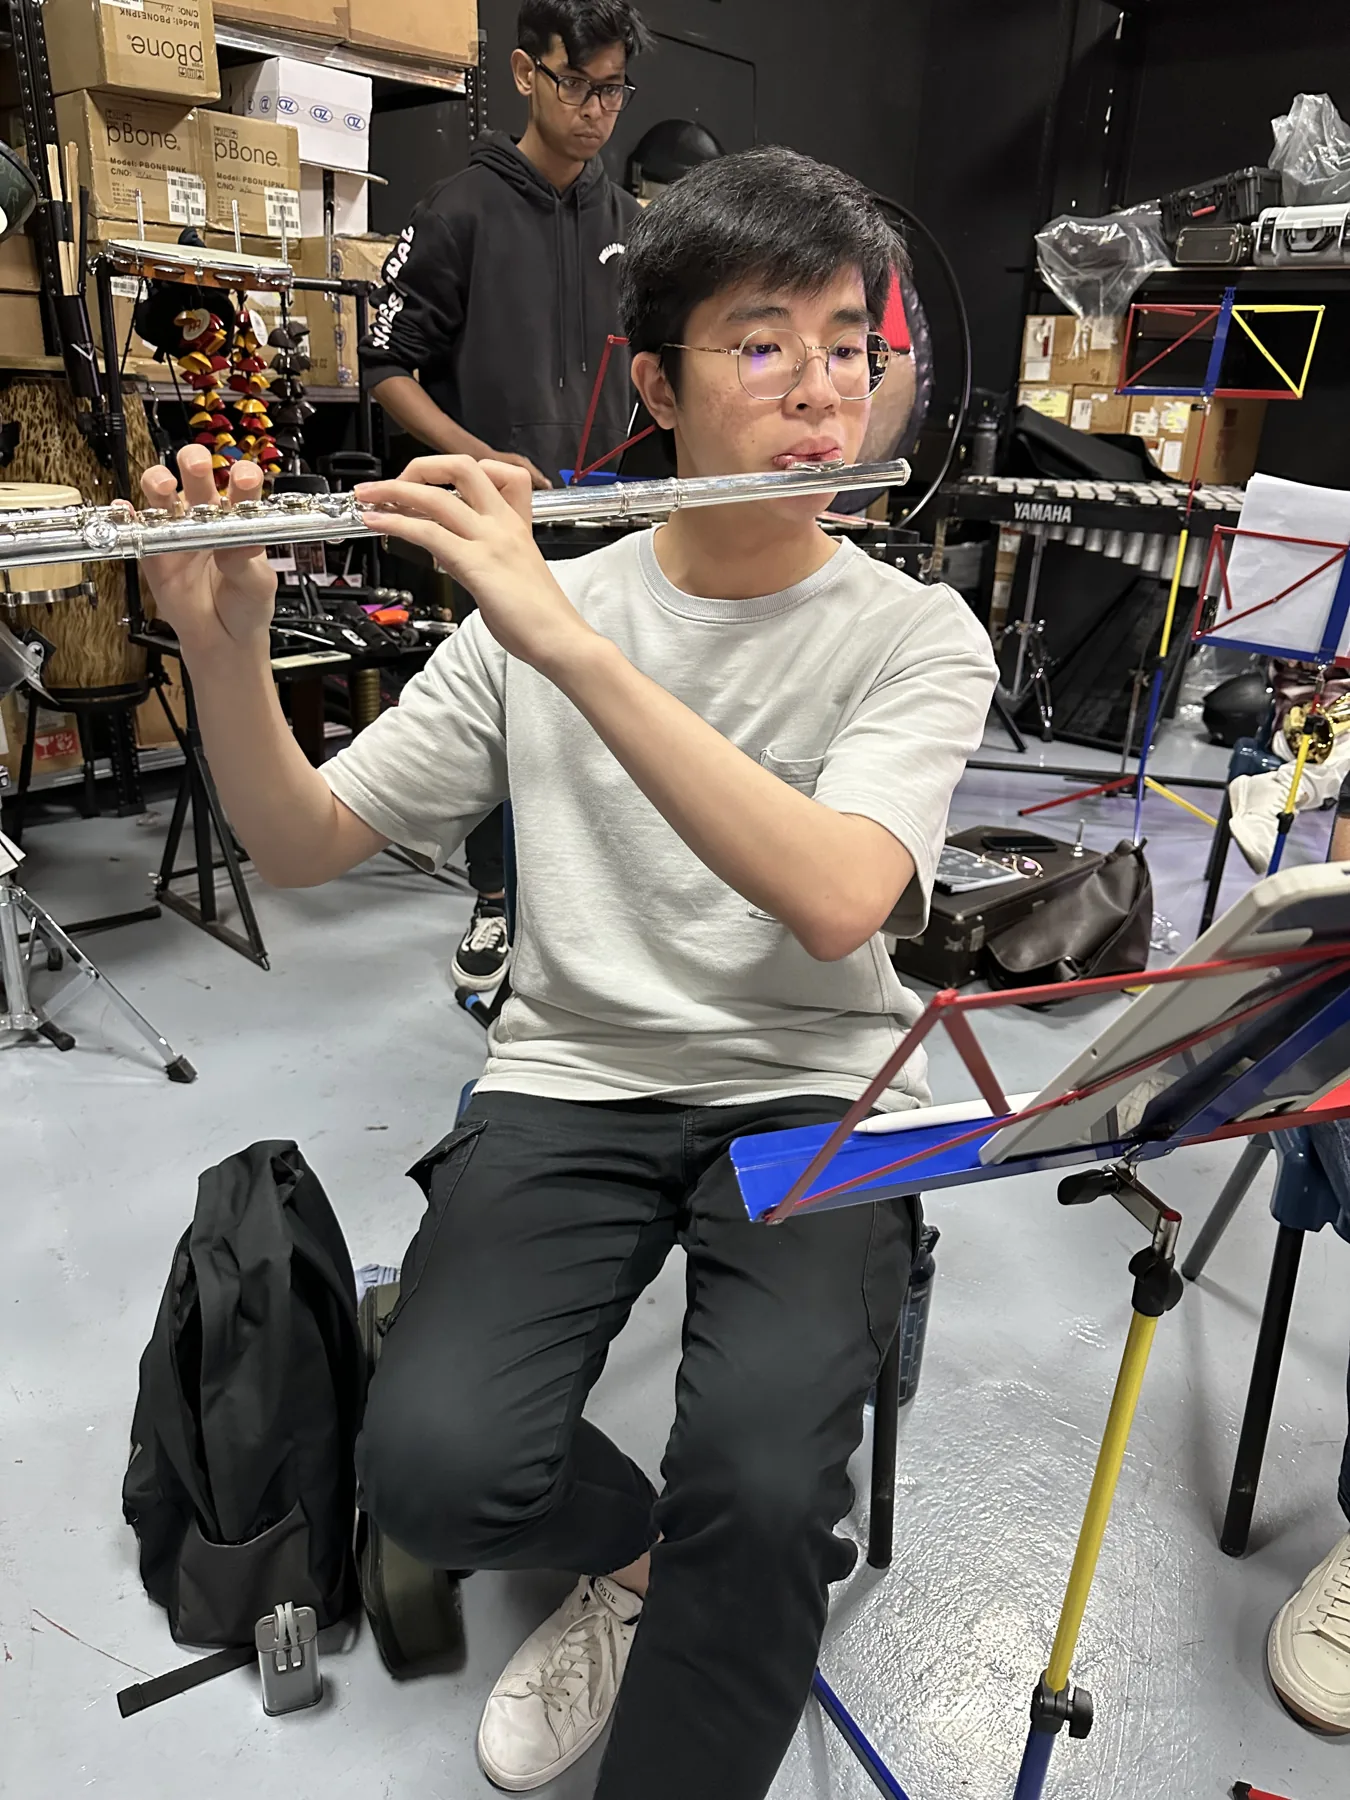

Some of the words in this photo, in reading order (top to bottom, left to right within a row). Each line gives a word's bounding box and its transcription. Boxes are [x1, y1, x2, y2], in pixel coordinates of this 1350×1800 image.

[120, 8, 171, 24] PBONE1PNK
[173, 17, 200, 29] Model:
[110, 157, 138, 167] Model:
[216, 172, 241, 182] Model:
[1014, 501, 1072, 524] YAMAHA
